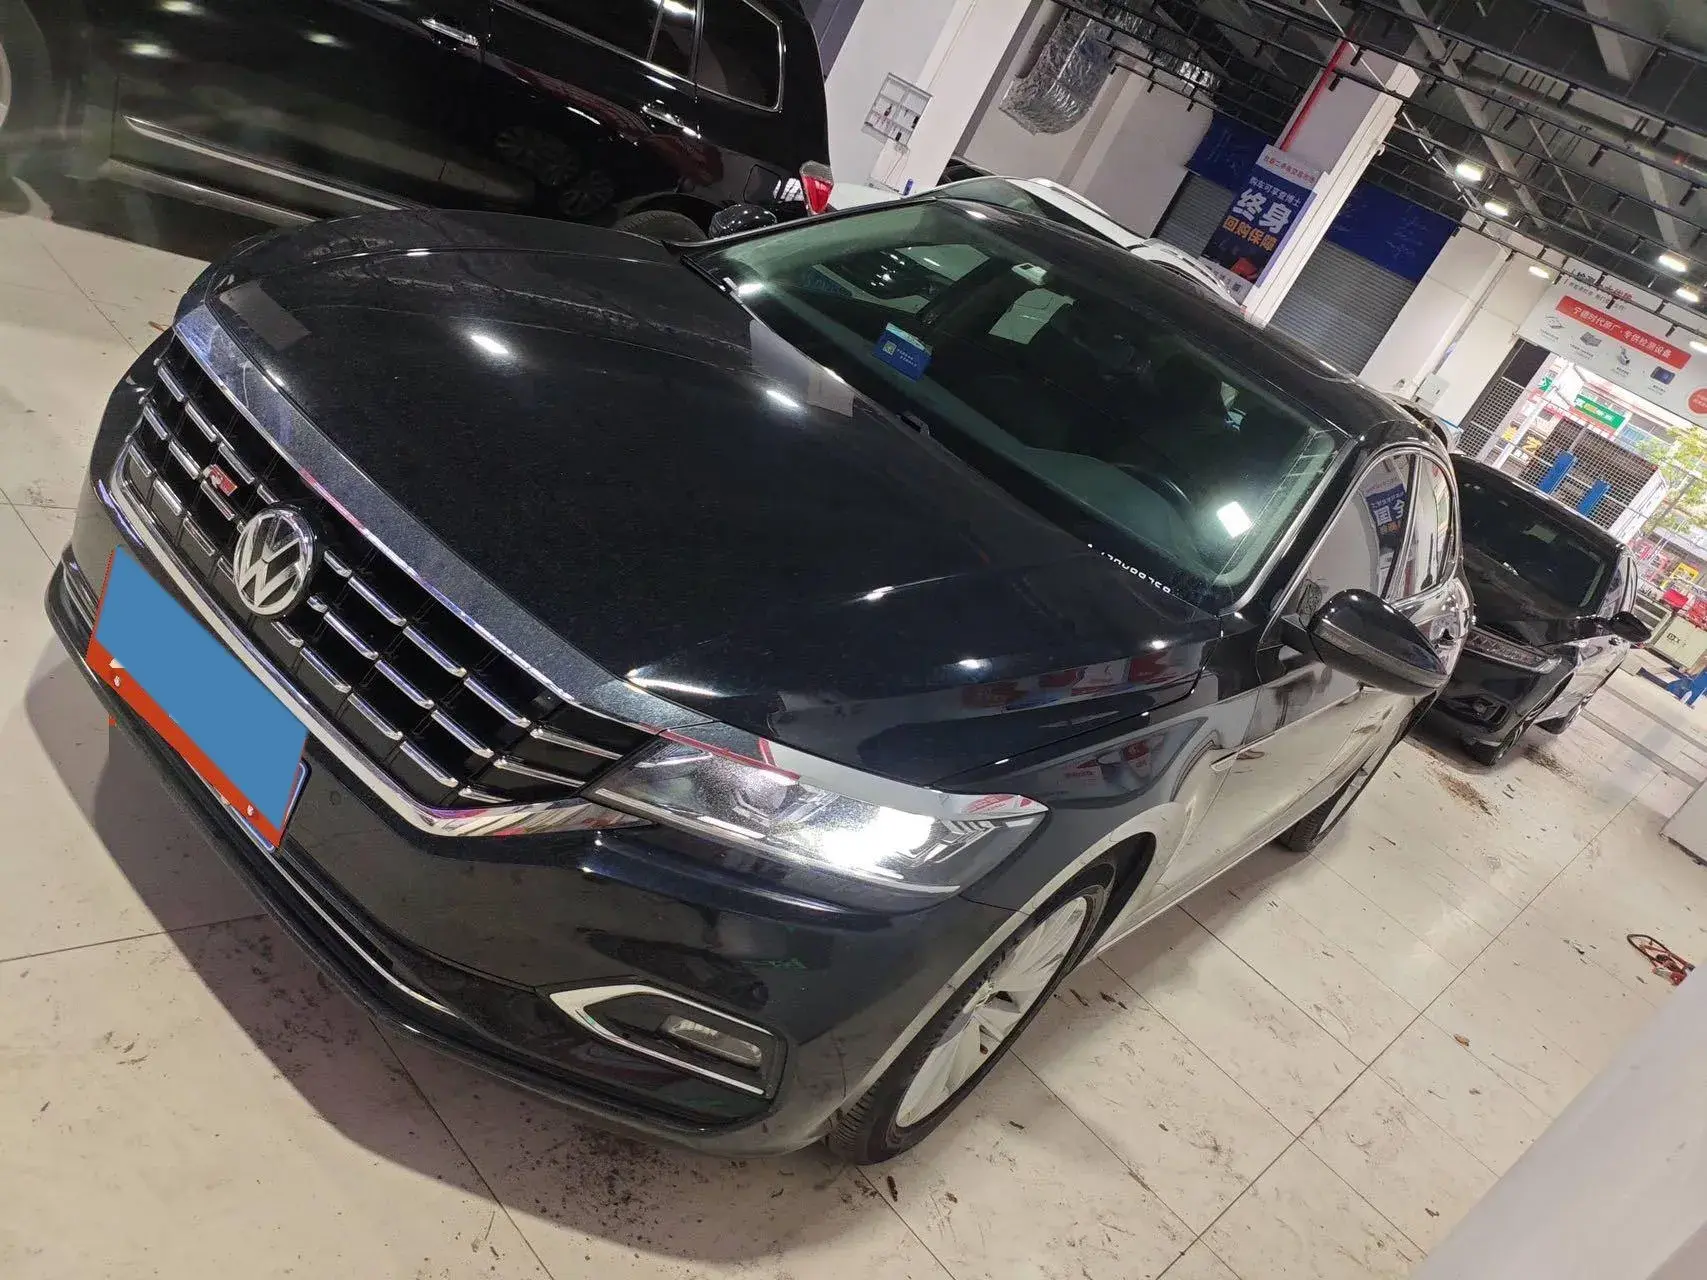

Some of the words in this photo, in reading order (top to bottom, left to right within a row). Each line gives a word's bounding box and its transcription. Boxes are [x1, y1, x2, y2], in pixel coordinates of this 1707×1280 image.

[1232, 188, 1293, 235] 终身
[1223, 214, 1278, 252] 回购保障
